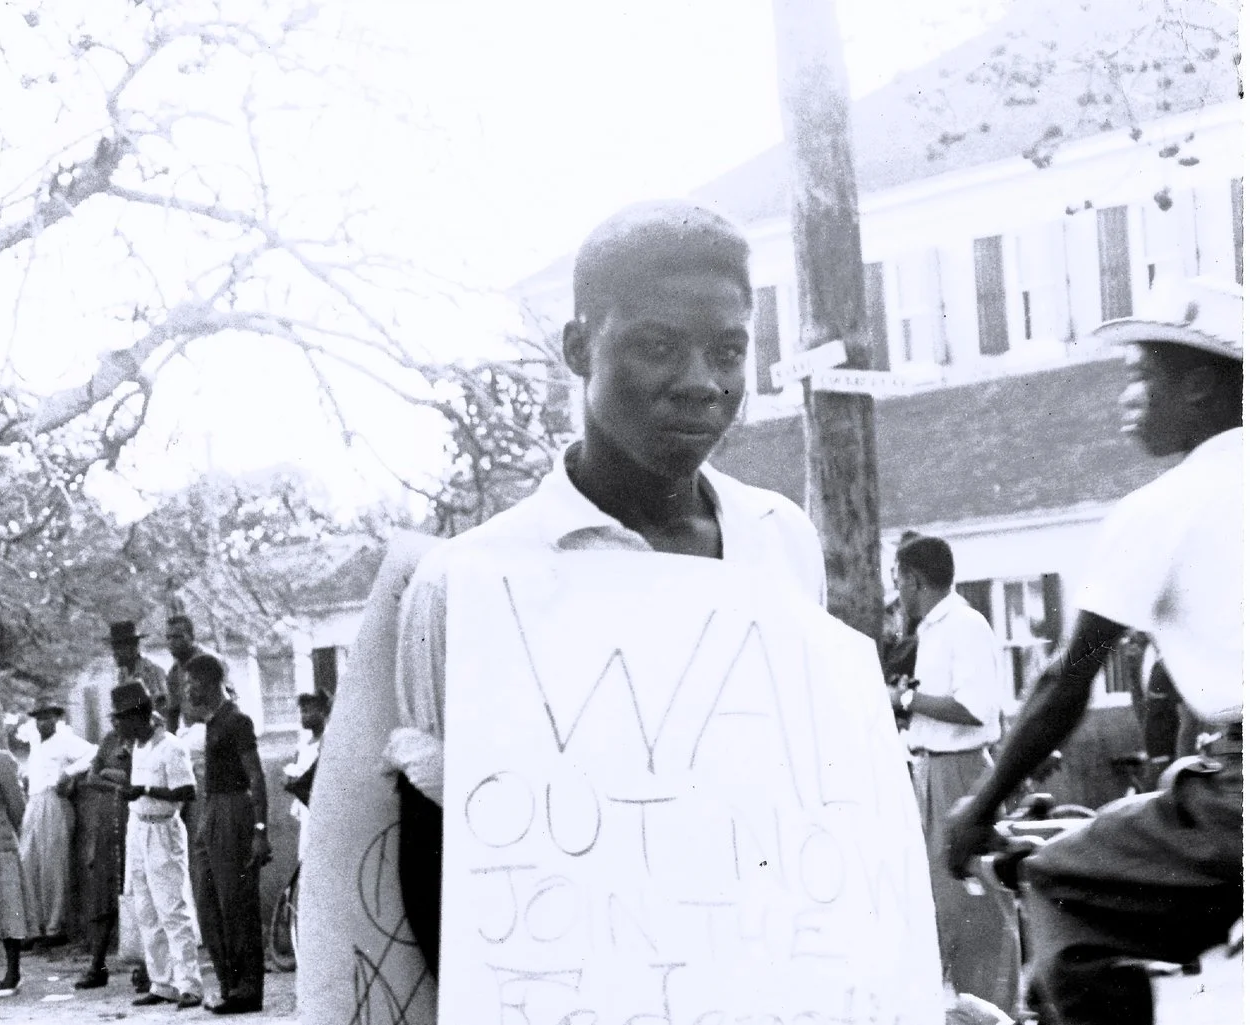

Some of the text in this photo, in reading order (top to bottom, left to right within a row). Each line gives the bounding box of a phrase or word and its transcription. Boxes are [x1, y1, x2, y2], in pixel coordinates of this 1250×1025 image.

[463, 768, 915, 932] OUT NOW
[470, 864, 847, 960] JOIN THE
